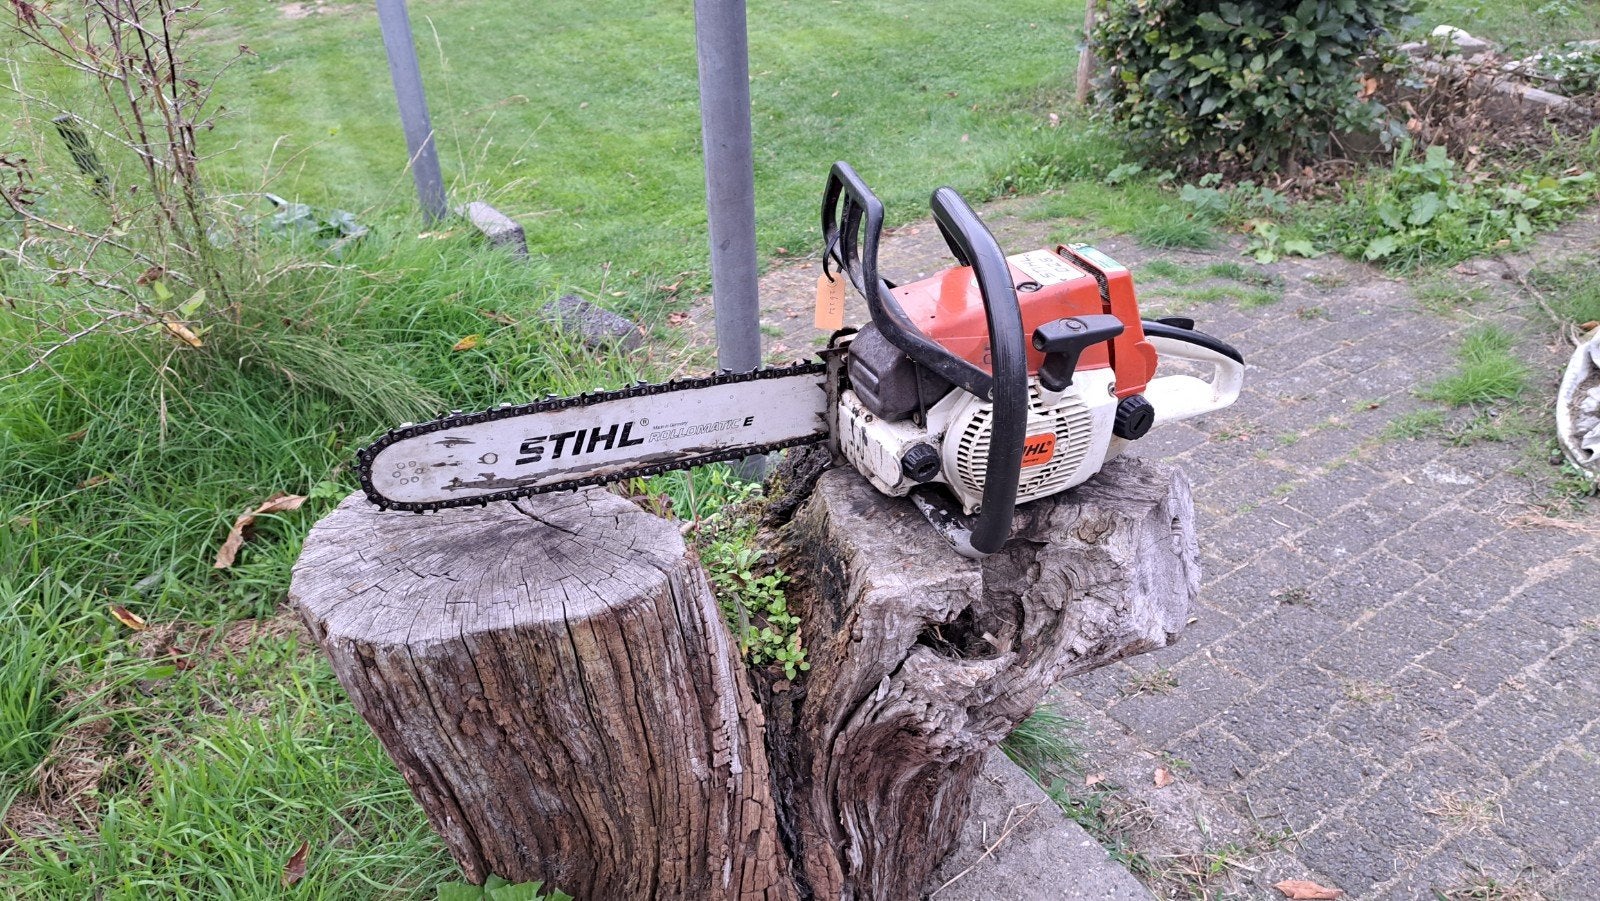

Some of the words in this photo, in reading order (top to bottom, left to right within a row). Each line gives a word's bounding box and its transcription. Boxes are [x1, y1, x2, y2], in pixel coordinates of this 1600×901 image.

[515, 421, 644, 466] STIHL
[649, 418, 741, 443] ROLLOMATIC
[743, 416, 755, 427] E
